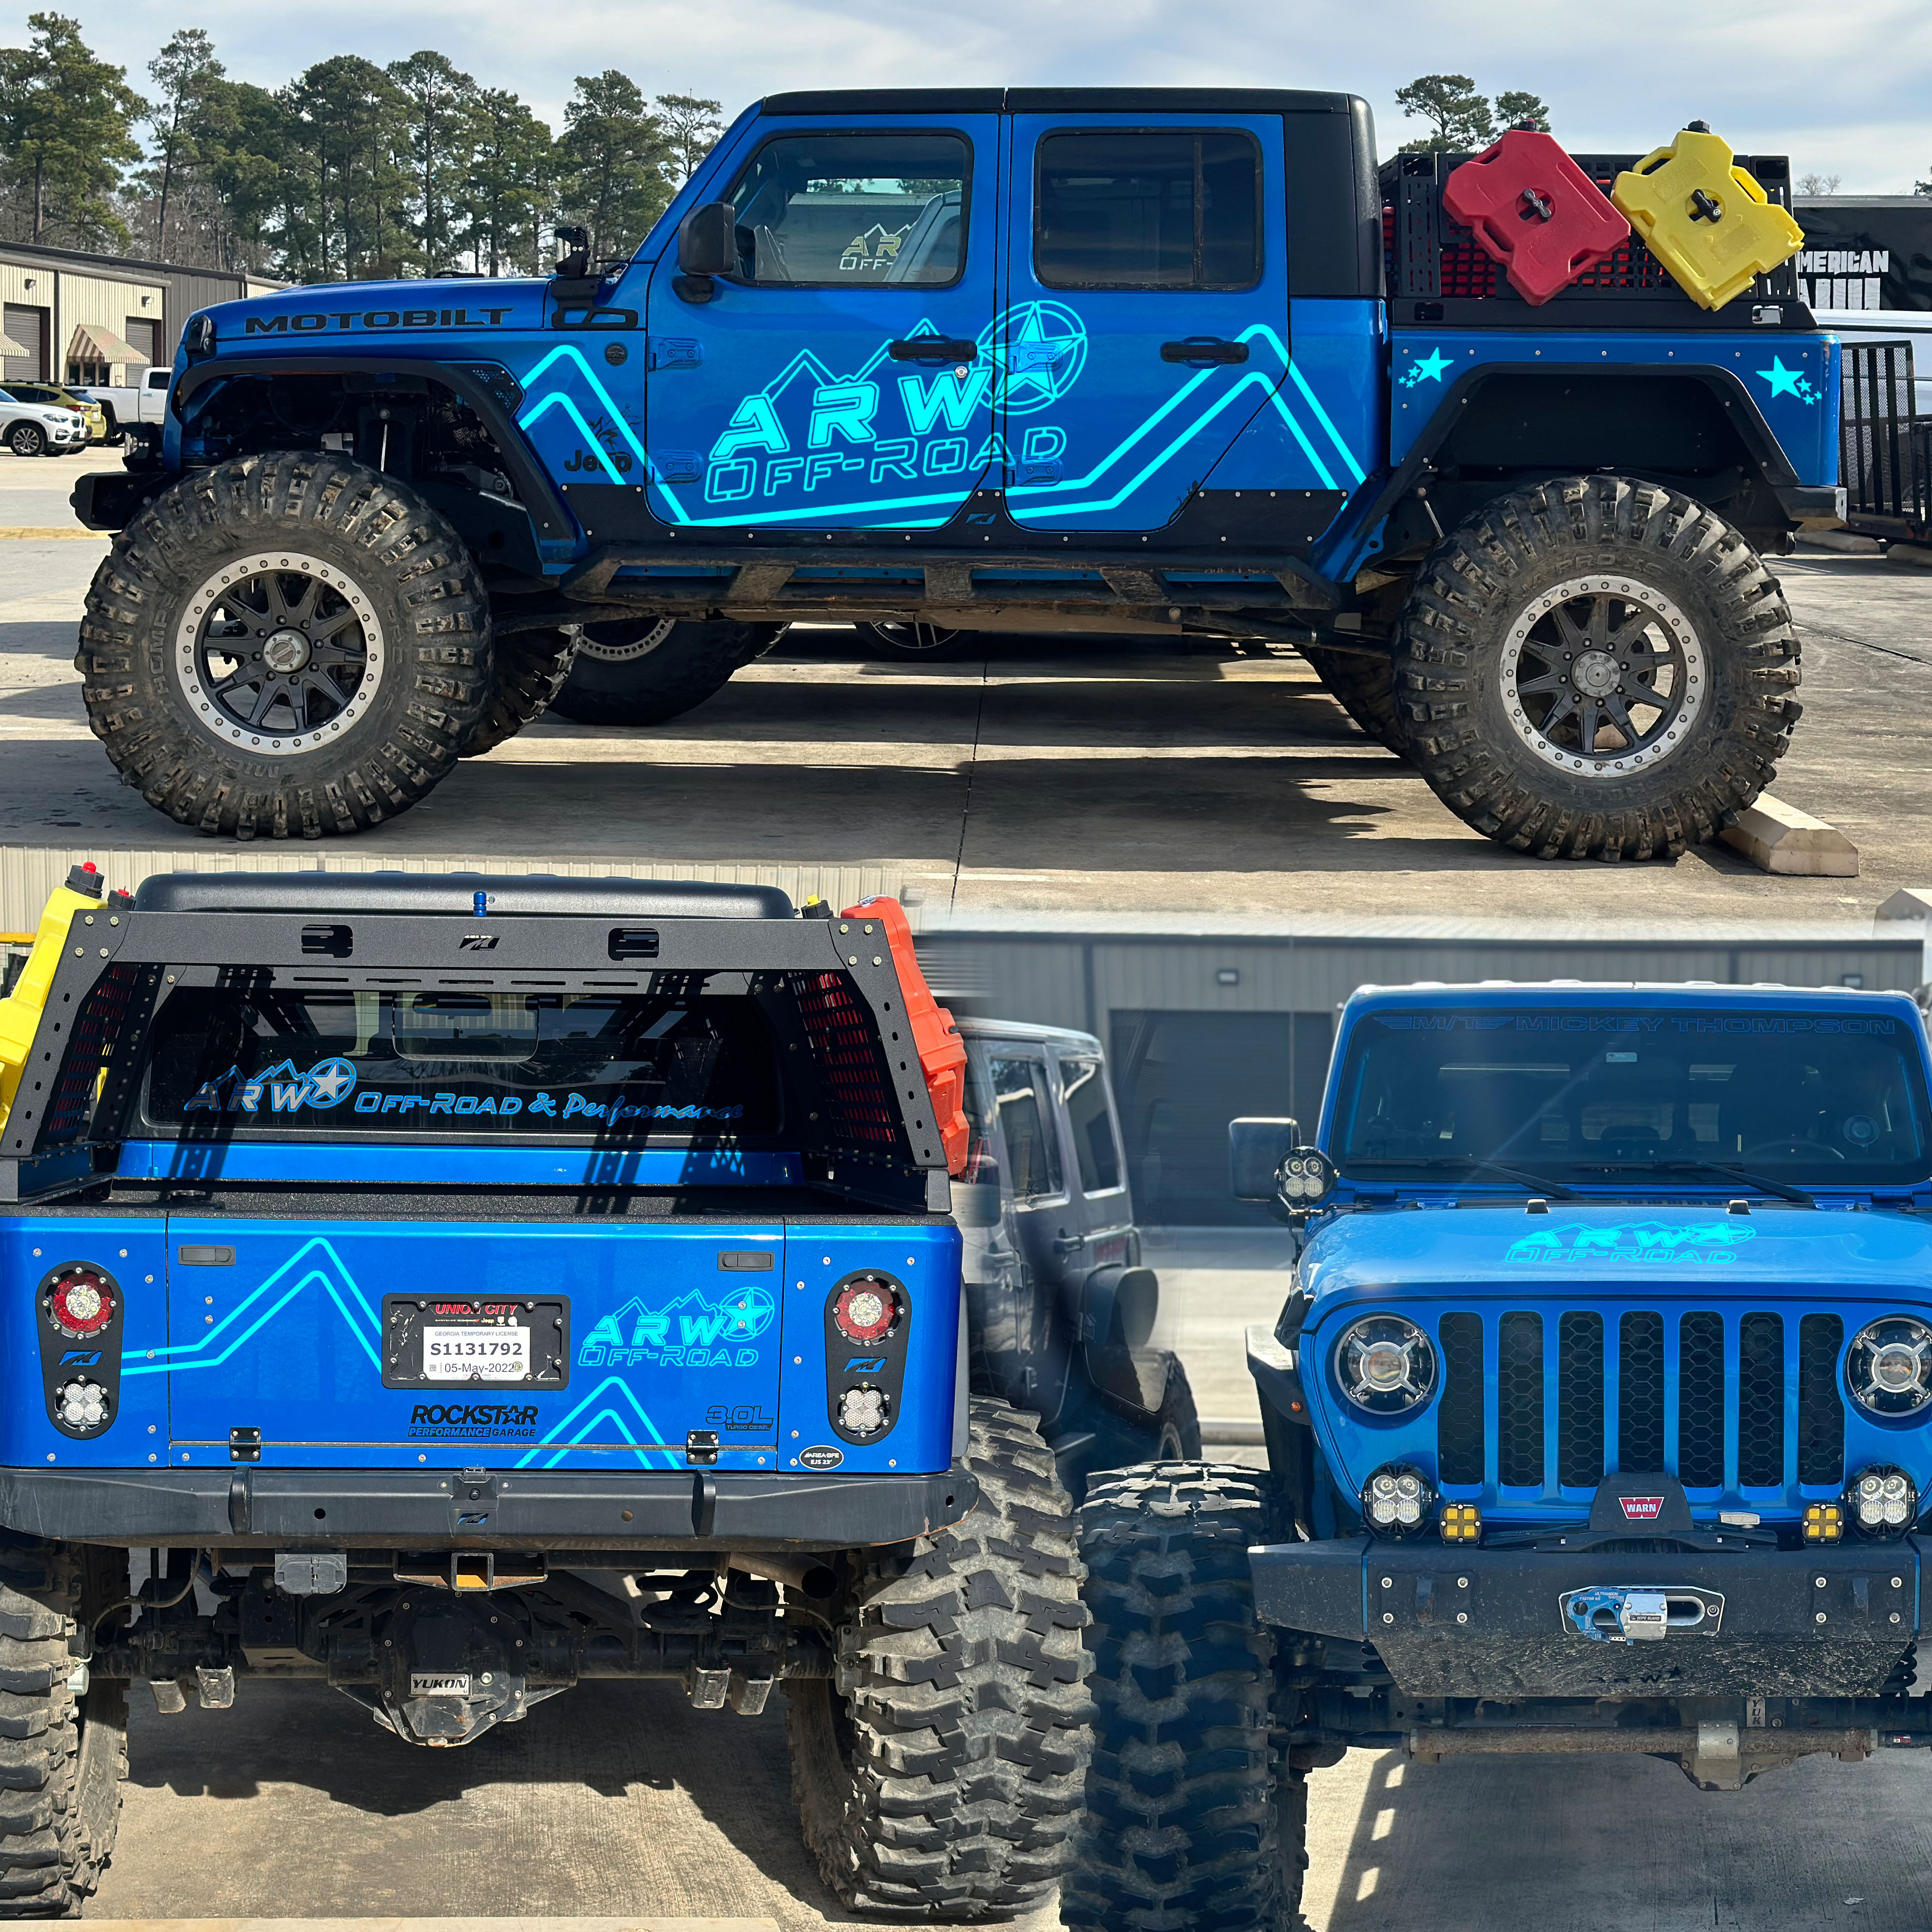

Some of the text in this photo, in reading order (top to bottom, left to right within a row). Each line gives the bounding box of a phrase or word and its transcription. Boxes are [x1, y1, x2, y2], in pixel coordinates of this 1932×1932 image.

[1796, 251, 1889, 274] MERICAN
[245, 308, 514, 333] MOTOBILT
[709, 366, 995, 460] ARW
[704, 426, 1066, 503] OFF-ROAD
[147, 589, 178, 716] THOMPS
[1516, 1016, 1665, 1032] MICKEY
[1671, 1017, 1895, 1034] THOMPSON
[184, 1082, 743, 1127] ARW OFF-ROAD & Performance
[1510, 1230, 1691, 1248] ARW
[1505, 1247, 1737, 1264] OFF-ROAD
[436, 1304, 519, 1315] UNIO CITY
[583, 1316, 727, 1346] ARW
[430, 1343, 522, 1355] S1131792
[578, 1346, 759, 1366] OFF-ROAD
[445, 1363, 514, 1373] 05-May-2022
[411, 1405, 539, 1425] ROCKSTAR
[706, 1406, 774, 1424] 3.0L
[410, 1427, 490, 1436] PERFORMANCE
[1627, 1504, 1656, 1512] WARN
[413, 1679, 468, 1689] YUKON
